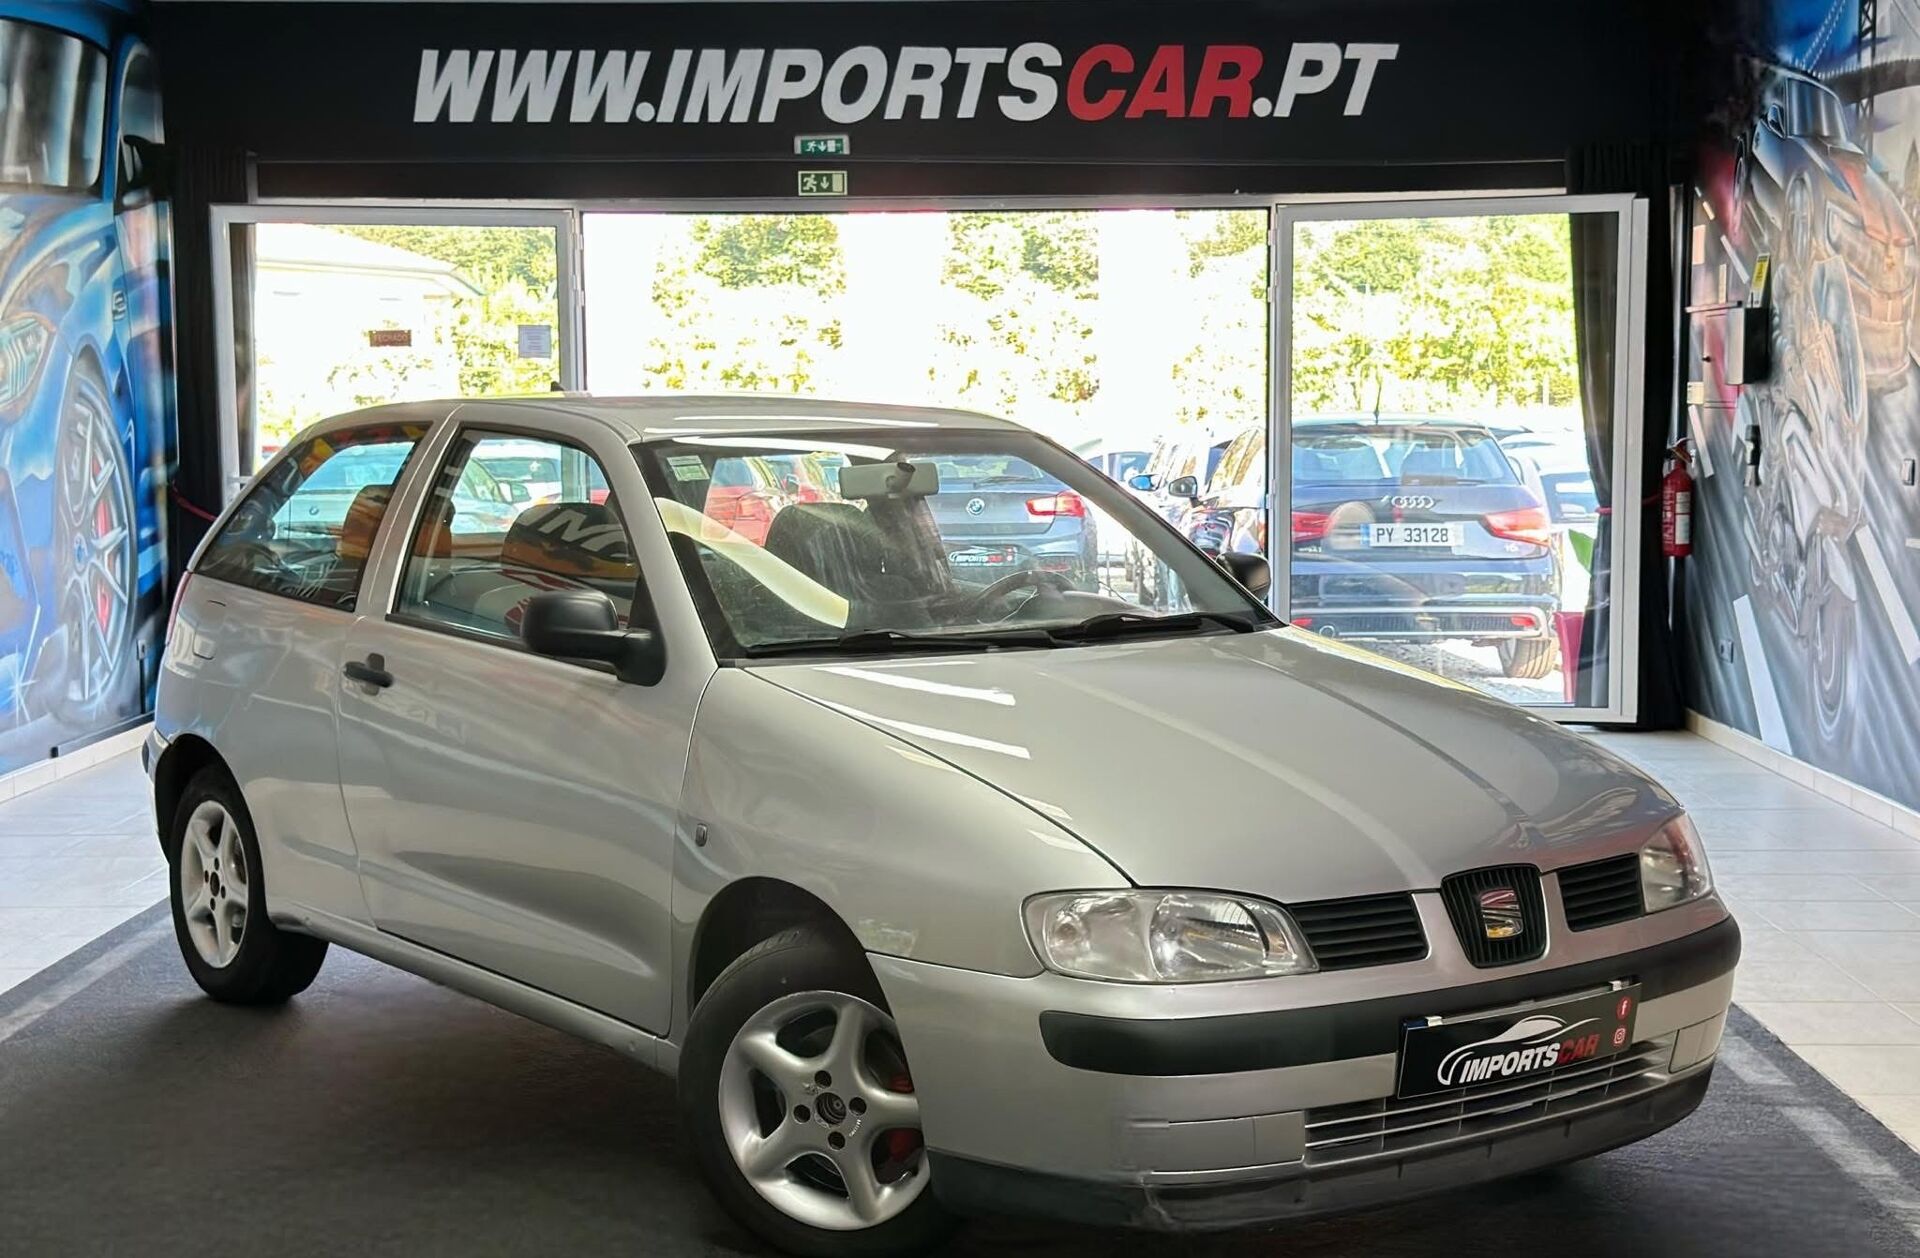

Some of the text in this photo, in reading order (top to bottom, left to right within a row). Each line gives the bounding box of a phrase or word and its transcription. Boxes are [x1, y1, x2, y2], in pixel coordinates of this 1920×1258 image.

[413, 42, 1399, 124] WWW.IMPORTSCAR.PT
[1376, 528, 1449, 542] PY 33128
[1459, 1034, 1600, 1083] IMPORTSCAR
